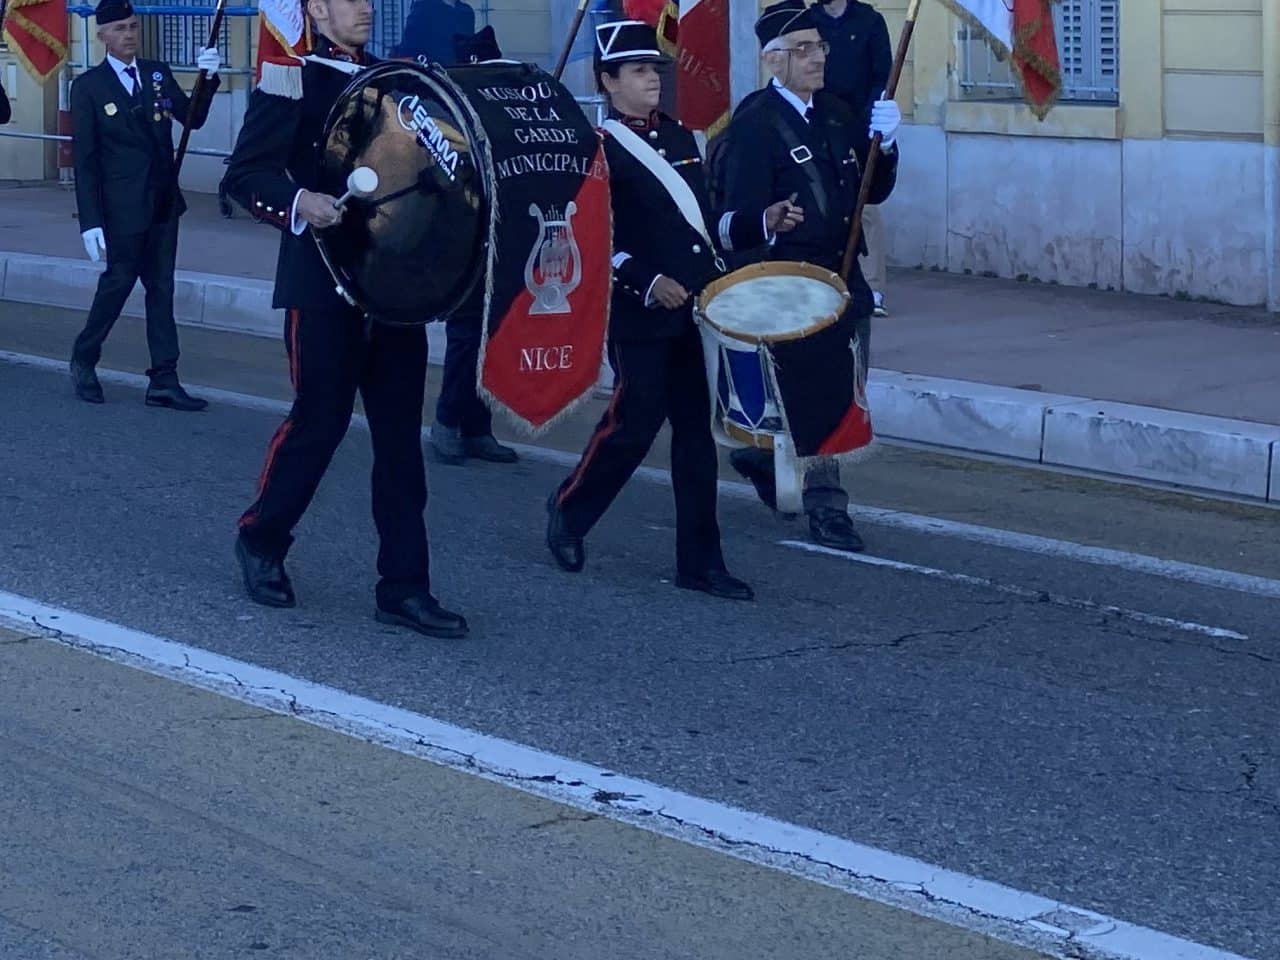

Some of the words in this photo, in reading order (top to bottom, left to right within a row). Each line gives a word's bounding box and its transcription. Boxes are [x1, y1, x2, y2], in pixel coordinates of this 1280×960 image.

[477, 81, 559, 103] MUSIQU
[504, 106, 532, 121] DE
[533, 106, 562, 122] LA
[514, 126, 579, 144] GARDE
[496, 152, 606, 180] MUNICIPALE
[519, 344, 574, 371] NICE
